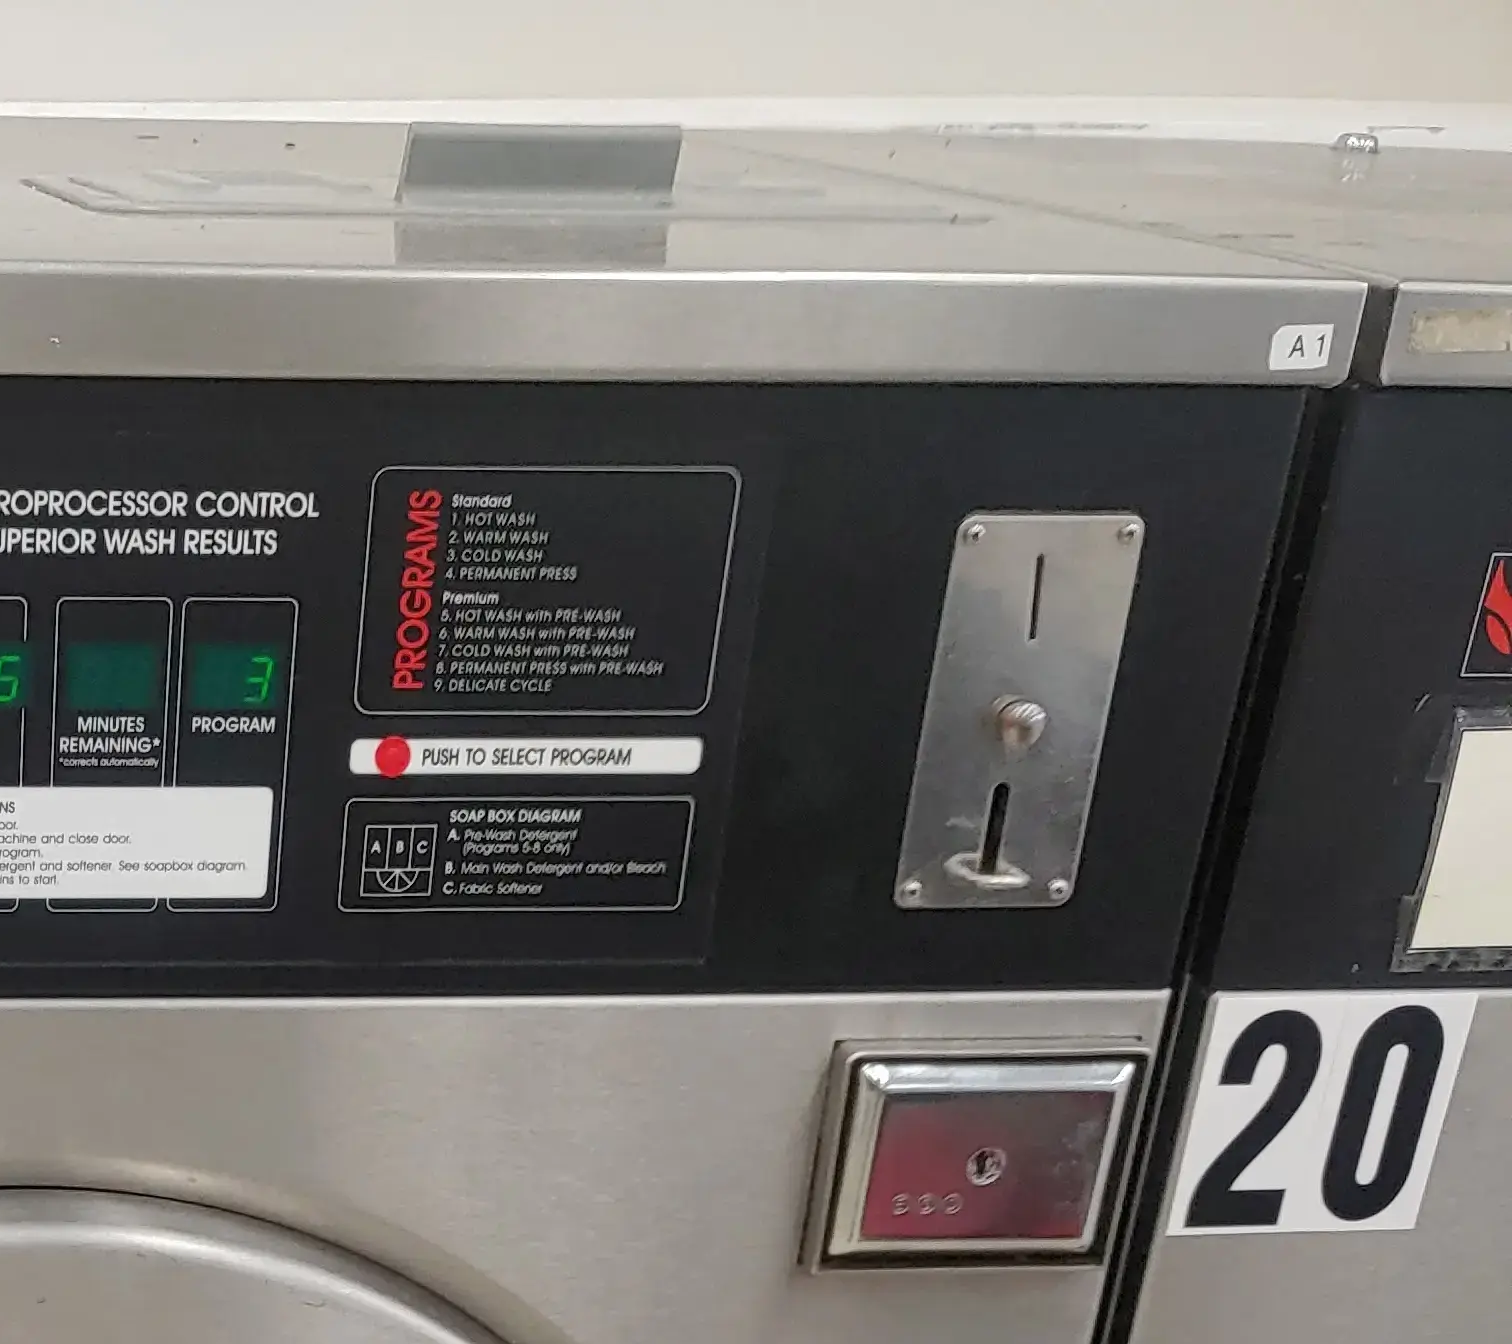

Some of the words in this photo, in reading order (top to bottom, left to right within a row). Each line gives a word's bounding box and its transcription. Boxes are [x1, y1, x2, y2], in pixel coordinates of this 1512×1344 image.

[1288, 334, 1305, 359] A
[1316, 333, 1327, 358] 1
[195, 491, 320, 519] CONTROL
[451, 493, 513, 508] Standard
[465, 512, 493, 526] HOT
[495, 512, 537, 526] WASH
[103, 529, 176, 555] WASH
[184, 529, 278, 555] RESULTS
[448, 530, 460, 544] 2.
[464, 530, 508, 544] WARM
[509, 530, 550, 545] WASH
[446, 549, 457, 563] 3.
[461, 549, 502, 562] COLD
[504, 549, 544, 563] WASH
[445, 566, 456, 580] 4.
[459, 566, 537, 581] PERMANENT
[539, 566, 578, 581] PRESS
[392, 488, 444, 690] PROGRAMS
[442, 591, 499, 605] Premium
[440, 609, 452, 622] 5.
[455, 609, 482, 622] HOT
[485, 609, 522, 622] WASH
[525, 609, 552, 622] with
[554, 609, 621, 623] PRE-WASH
[439, 627, 450, 640] 6.
[453, 627, 496, 640] WARM
[498, 627, 536, 640] WASH
[538, 627, 565, 640] with
[567, 627, 636, 641] PRE-WASH
[451, 644, 491, 657] COLD
[493, 644, 531, 657] WASH
[533, 644, 560, 657] with
[562, 644, 630, 658] PRE-WASH
[449, 662, 527, 675] PERMANENT
[529, 662, 567, 675] PRESS
[569, 662, 596, 675] with
[598, 662, 665, 676] PRE-WASH
[244, 656, 274, 701] 3
[448, 679, 508, 692] DELICATE
[510, 679, 553, 692] CYCLE
[77, 716, 145, 733] MINUTES
[191, 716, 276, 733] PROGRAM
[421, 748, 459, 766] PUSH
[465, 748, 486, 766] TO
[491, 748, 546, 766] SELECT
[550, 747, 633, 766] PROGRAM
[449, 809, 485, 823] SOAP
[487, 809, 516, 823] BOX
[517, 808, 583, 823] DIAGRAM
[41, 833, 65, 844] and
[68, 833, 99, 844] close
[103, 832, 132, 844] door.
[447, 829, 460, 841] A.
[464, 829, 516, 842] Pre-Wash
[519, 829, 579, 844] Detergent
[370, 840, 382, 853] A
[395, 841, 405, 853] B
[416, 841, 429, 853] C
[39, 860, 63, 871] and
[118, 860, 139, 871] See
[143, 860, 193, 873] soapbox
[444, 861, 456, 875] B.
[460, 861, 490, 875] Main
[492, 861, 524, 875] Wash
[525, 861, 584, 877] Detergent
[18, 874, 30, 885] to
[442, 881, 458, 895] C.
[459, 881, 493, 895] Fabric
[496, 881, 543, 895] Softener
[1184, 1004, 1445, 1228] 20
